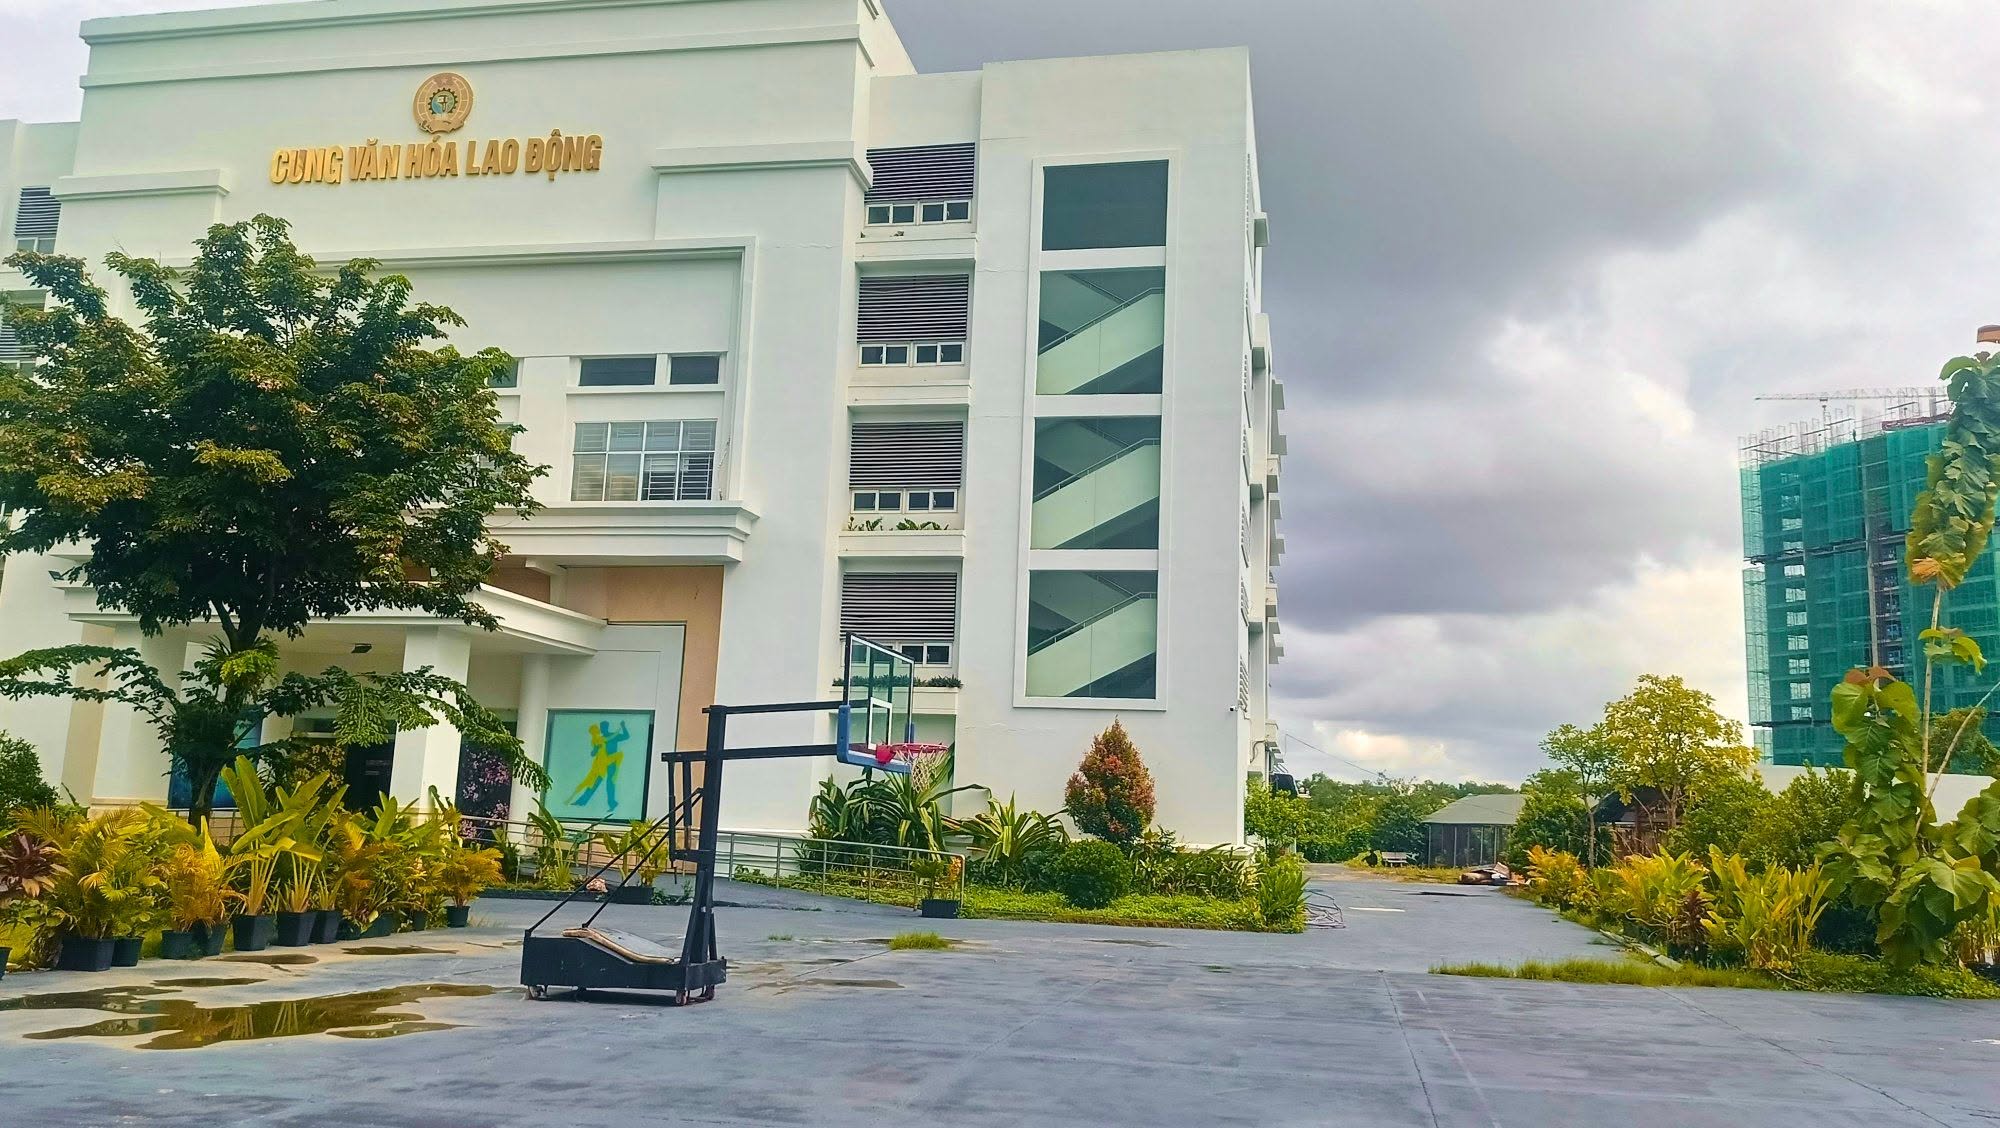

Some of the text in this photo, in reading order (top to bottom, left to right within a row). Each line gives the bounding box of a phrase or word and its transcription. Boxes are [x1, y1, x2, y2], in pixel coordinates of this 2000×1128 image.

[270, 129, 602, 184] CUNG VĂN HÓA LAO ĐỘNG
